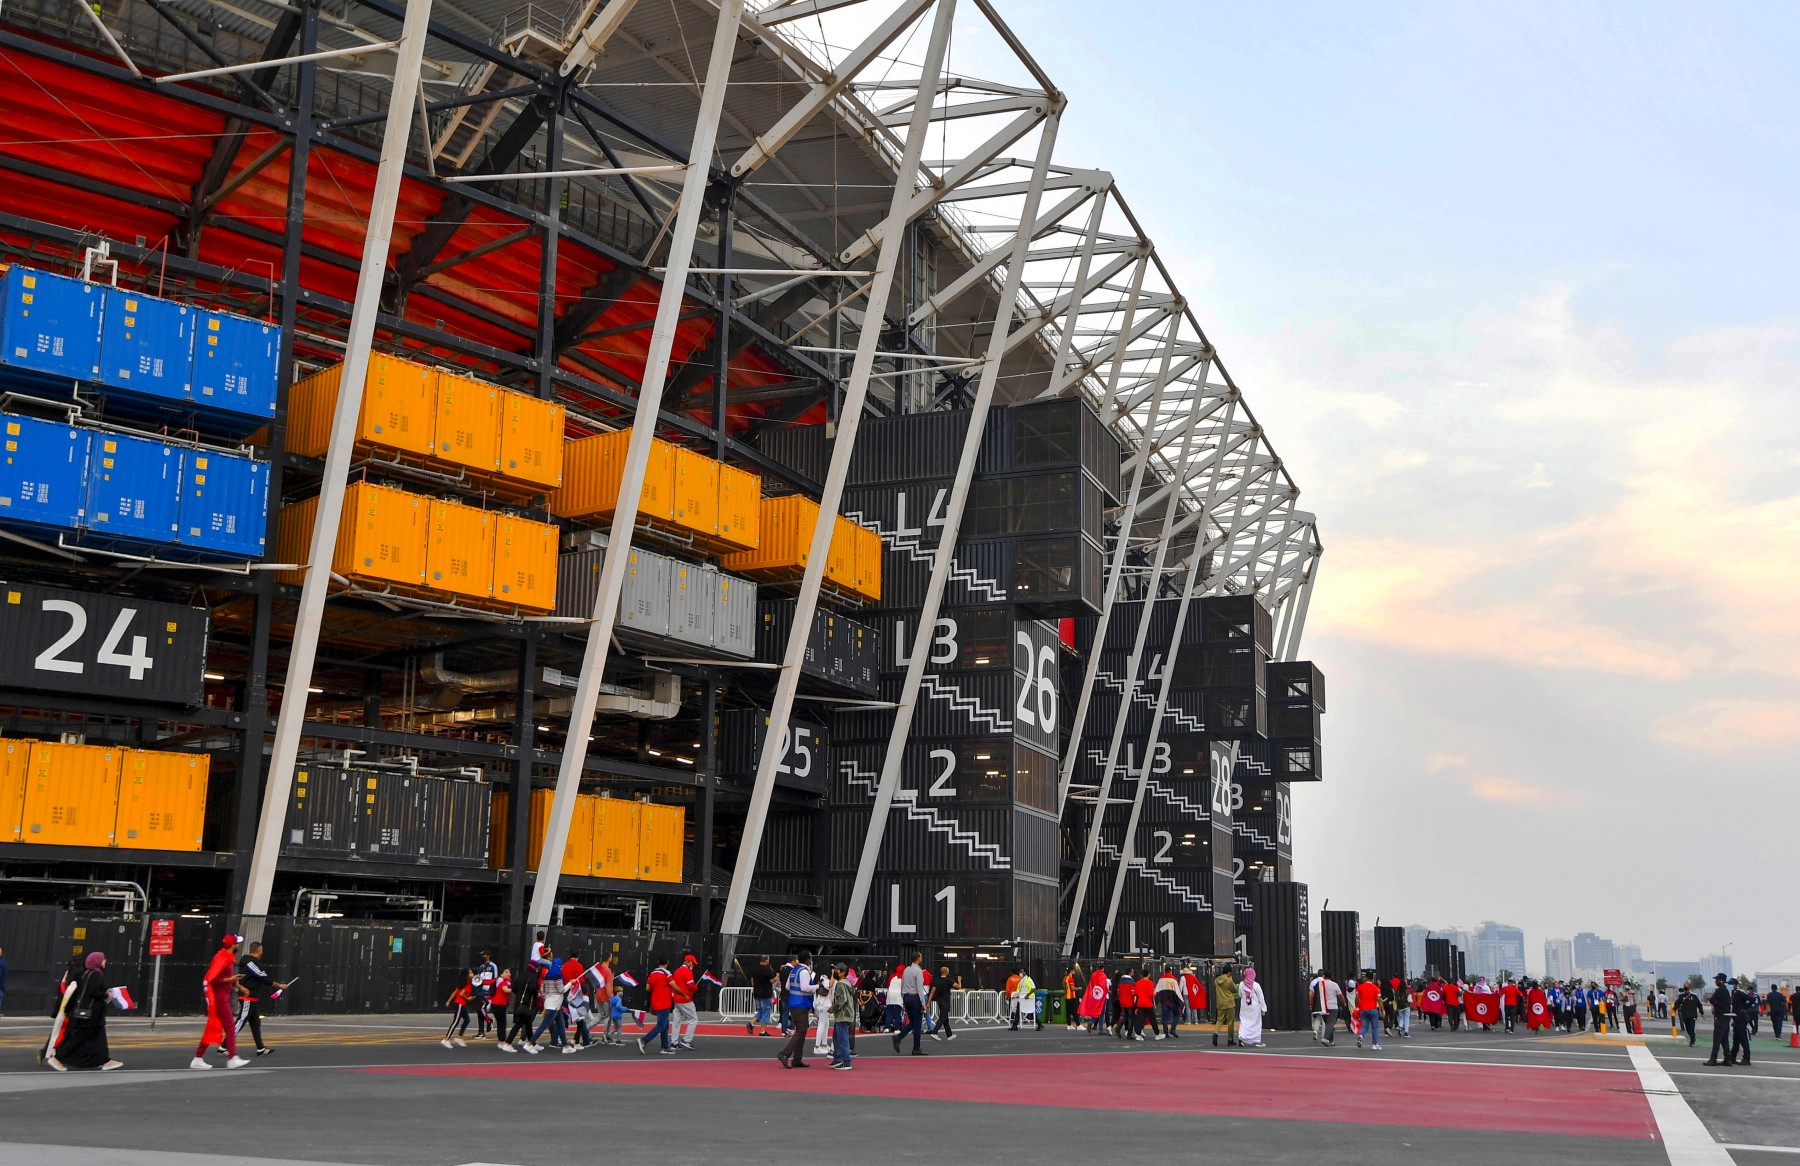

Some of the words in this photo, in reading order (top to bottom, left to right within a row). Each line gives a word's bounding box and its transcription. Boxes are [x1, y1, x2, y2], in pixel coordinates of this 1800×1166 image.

[35, 599, 153, 681] 24
[1017, 630, 1056, 734] 26
[1211, 750, 1231, 817] 28
[1277, 791, 1290, 846] 29
